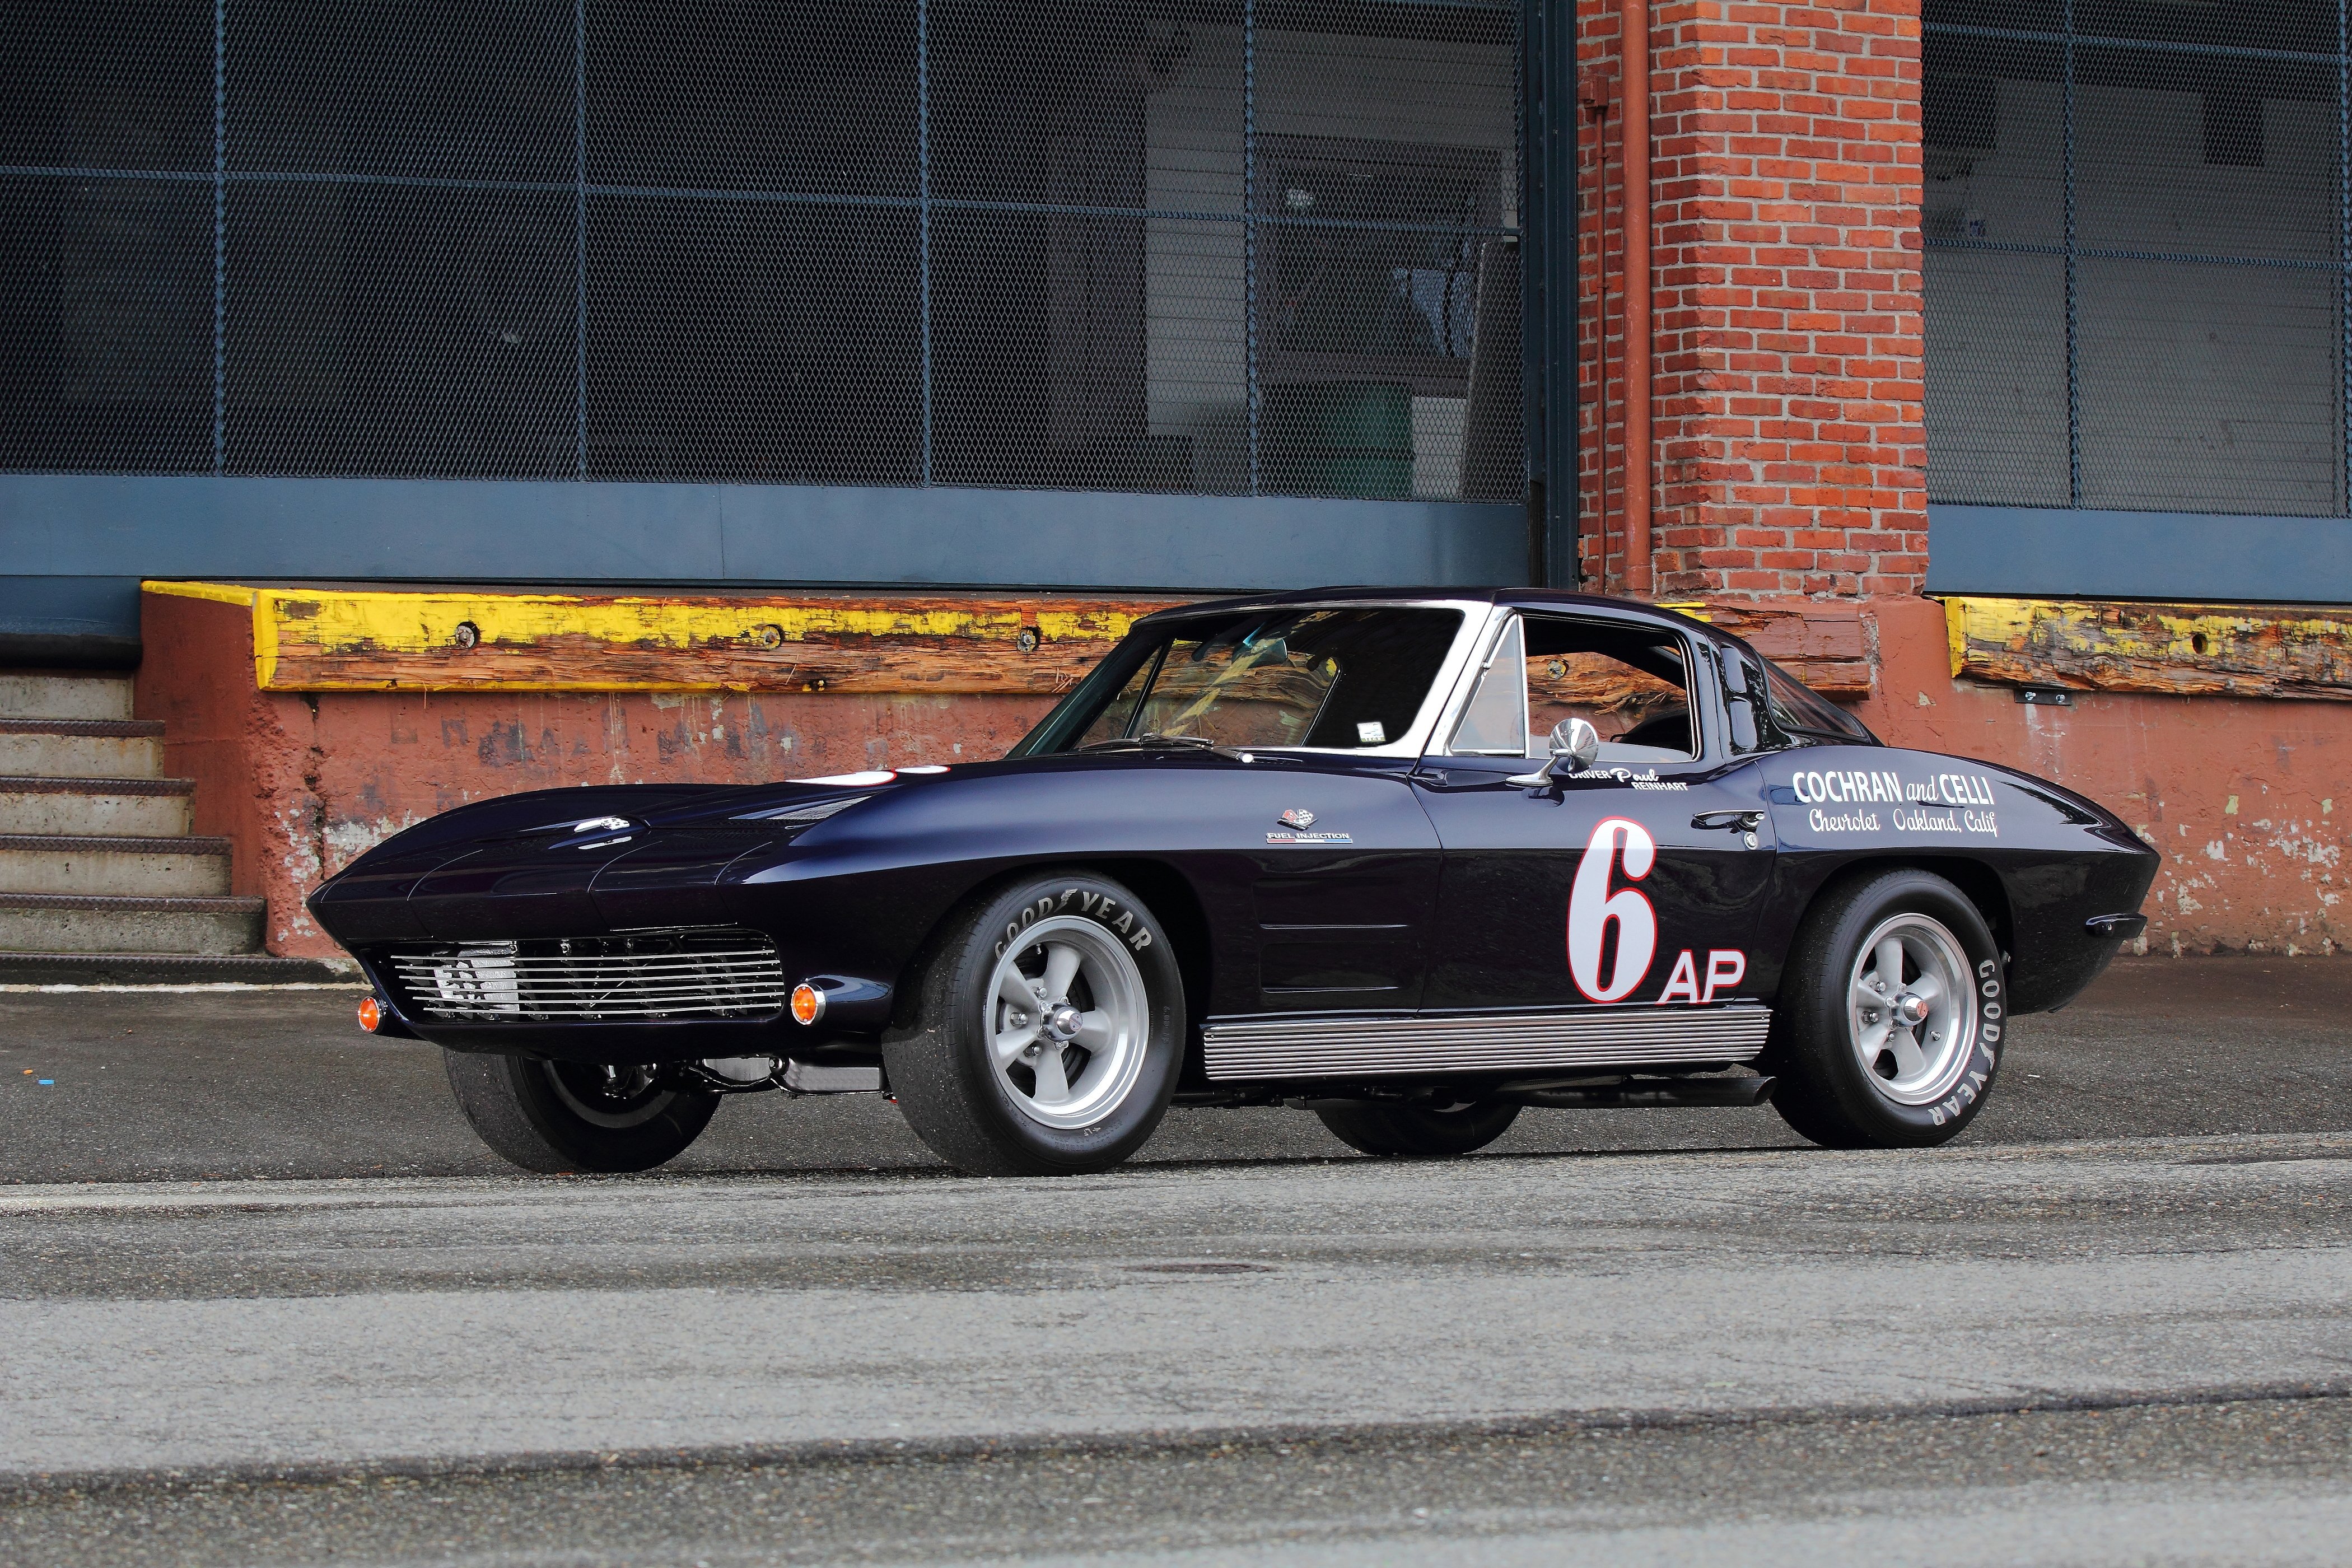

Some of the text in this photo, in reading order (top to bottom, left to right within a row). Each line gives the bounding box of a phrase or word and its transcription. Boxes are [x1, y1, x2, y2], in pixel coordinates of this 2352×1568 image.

[1609, 768, 1659, 782] Paul
[1631, 782, 1688, 791] REINHART
[1792, 771, 1994, 805] COCHRAN and CELLI
[1809, 809, 1998, 838] Chevrolet Oakland, Calif
[1566, 815, 1658, 1004] 6
[1655, 949, 1747, 1005] AP
